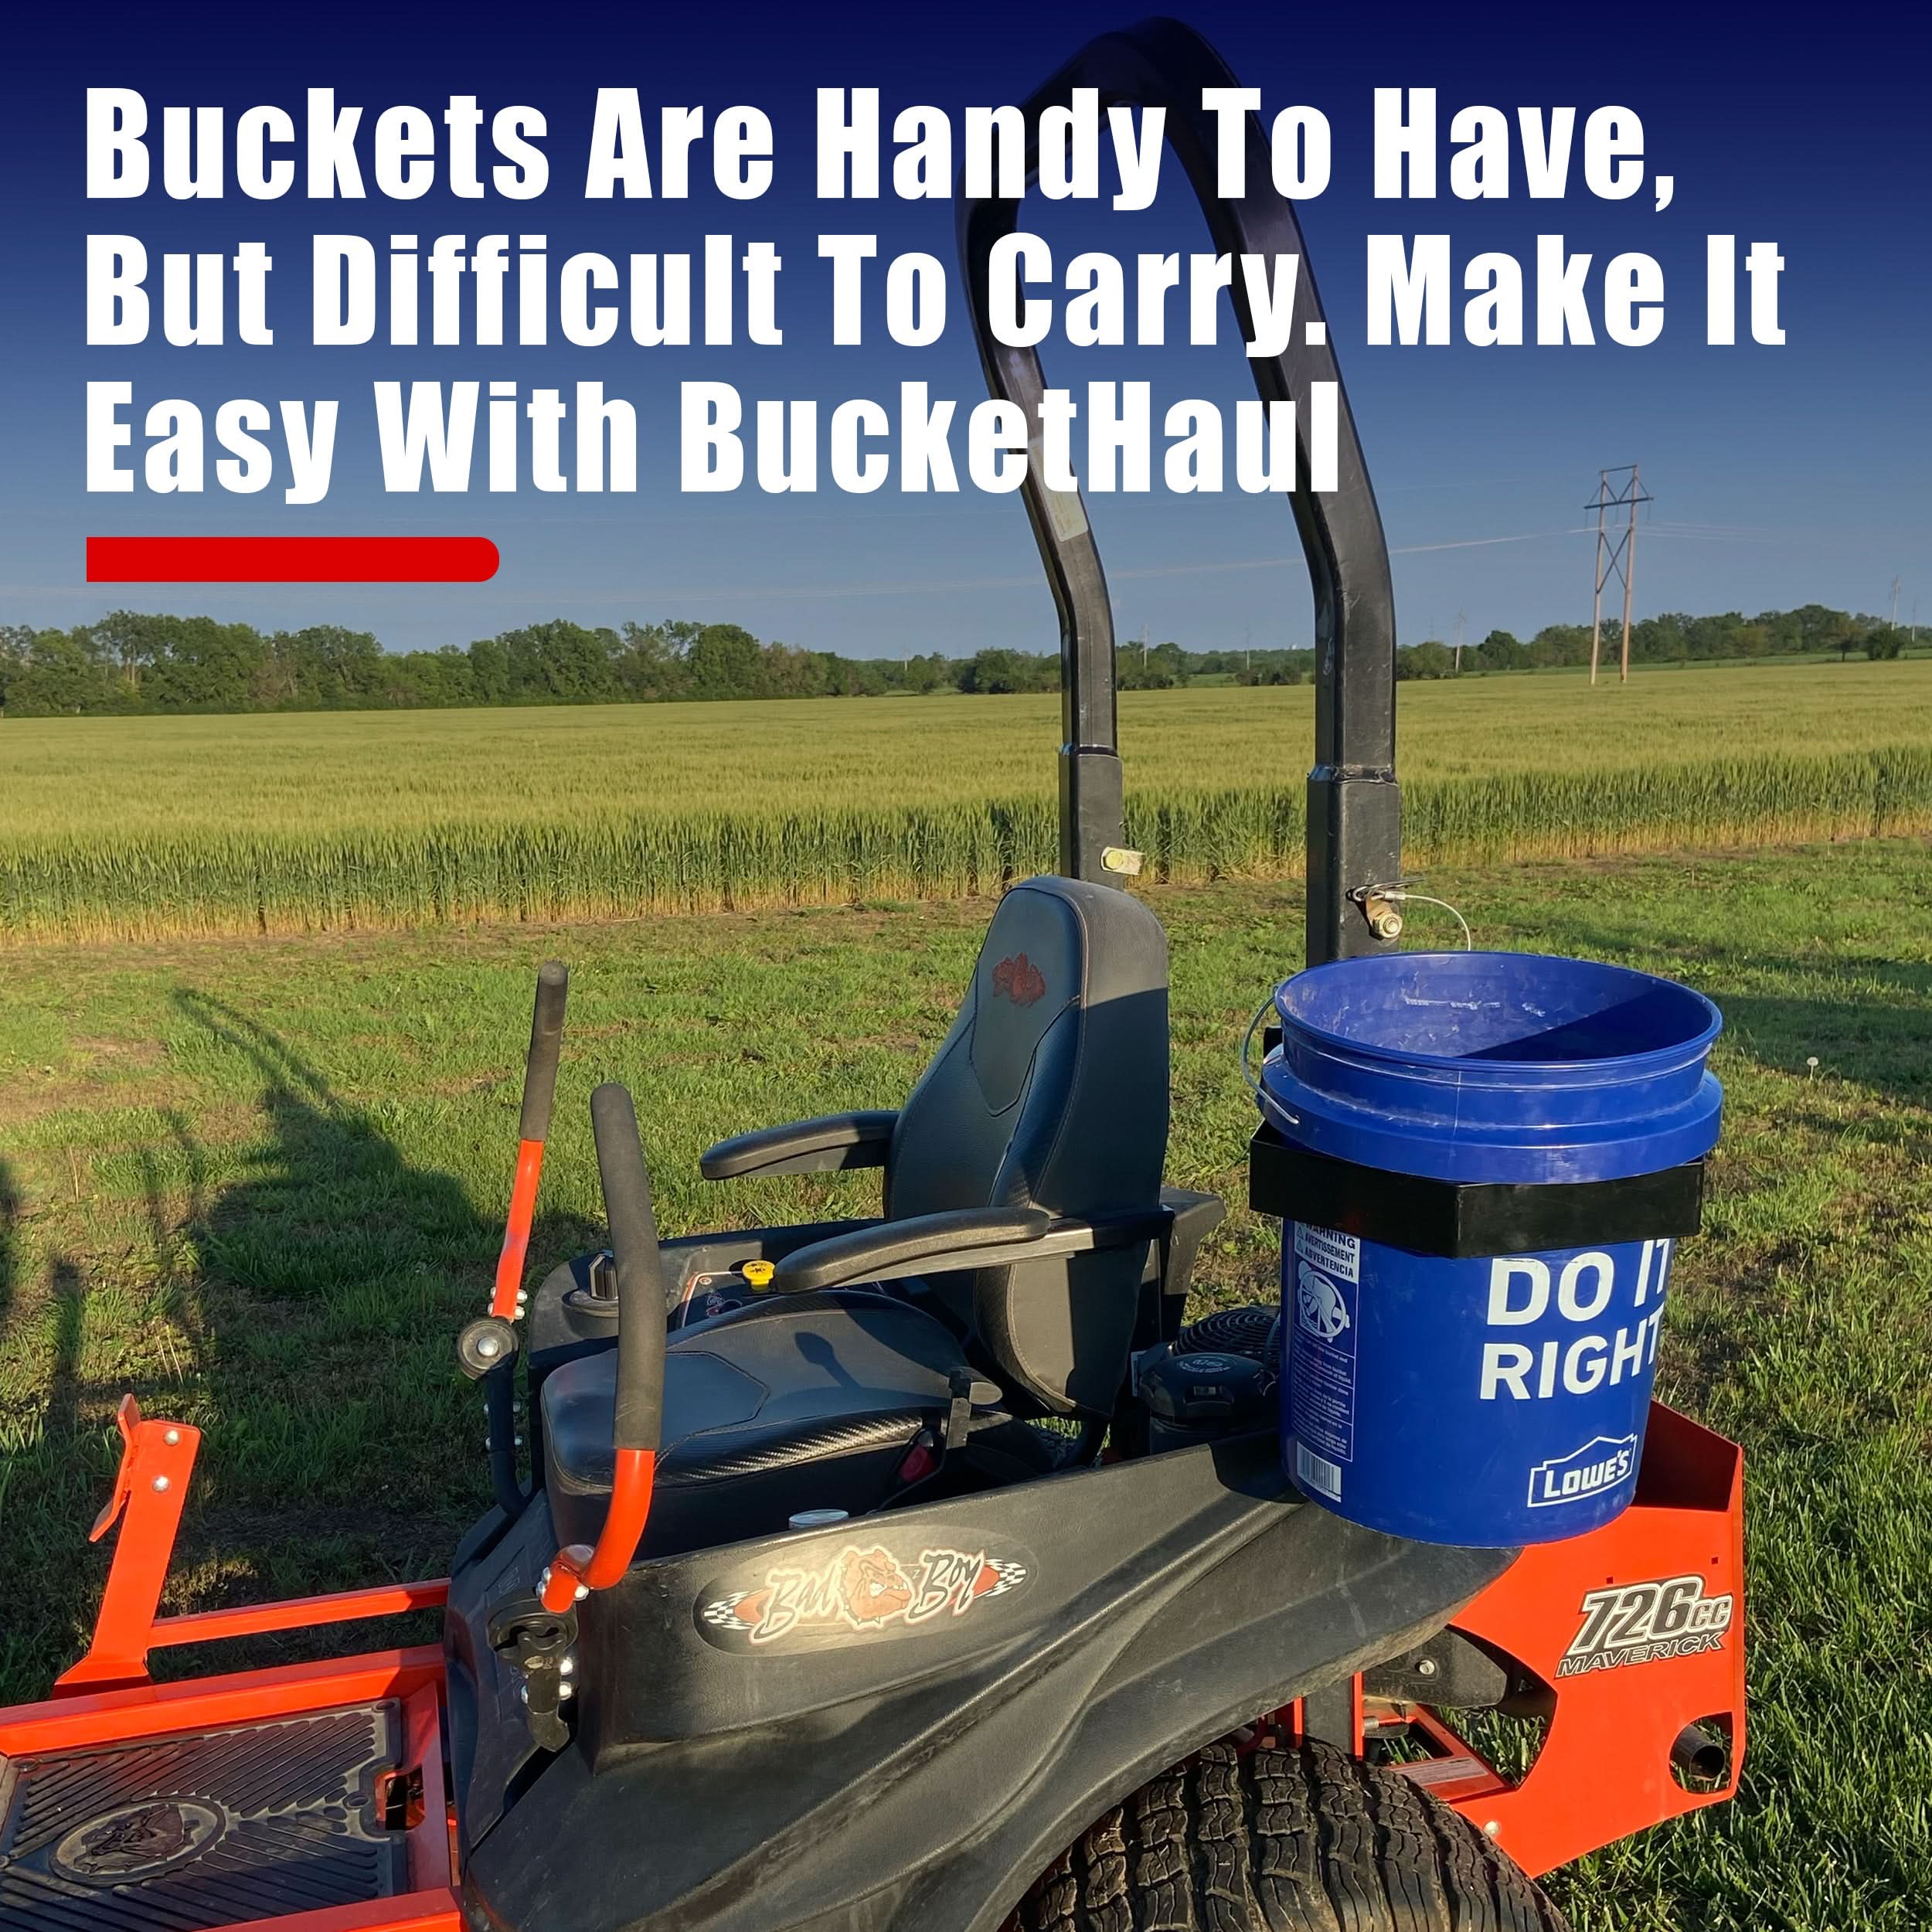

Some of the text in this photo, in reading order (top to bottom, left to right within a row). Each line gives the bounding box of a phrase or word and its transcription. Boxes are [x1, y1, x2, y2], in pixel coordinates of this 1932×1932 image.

[1304, 1246, 1353, 1277] ADVERTENCIA
[1487, 1238, 1670, 1325] DO IT
[1480, 1302, 1665, 1400] RIGHT
[1543, 1450, 1629, 1498] LOWE'S
[906, 1549, 987, 1616] Boy
[1555, 1631, 1725, 1678] MAVERICK
